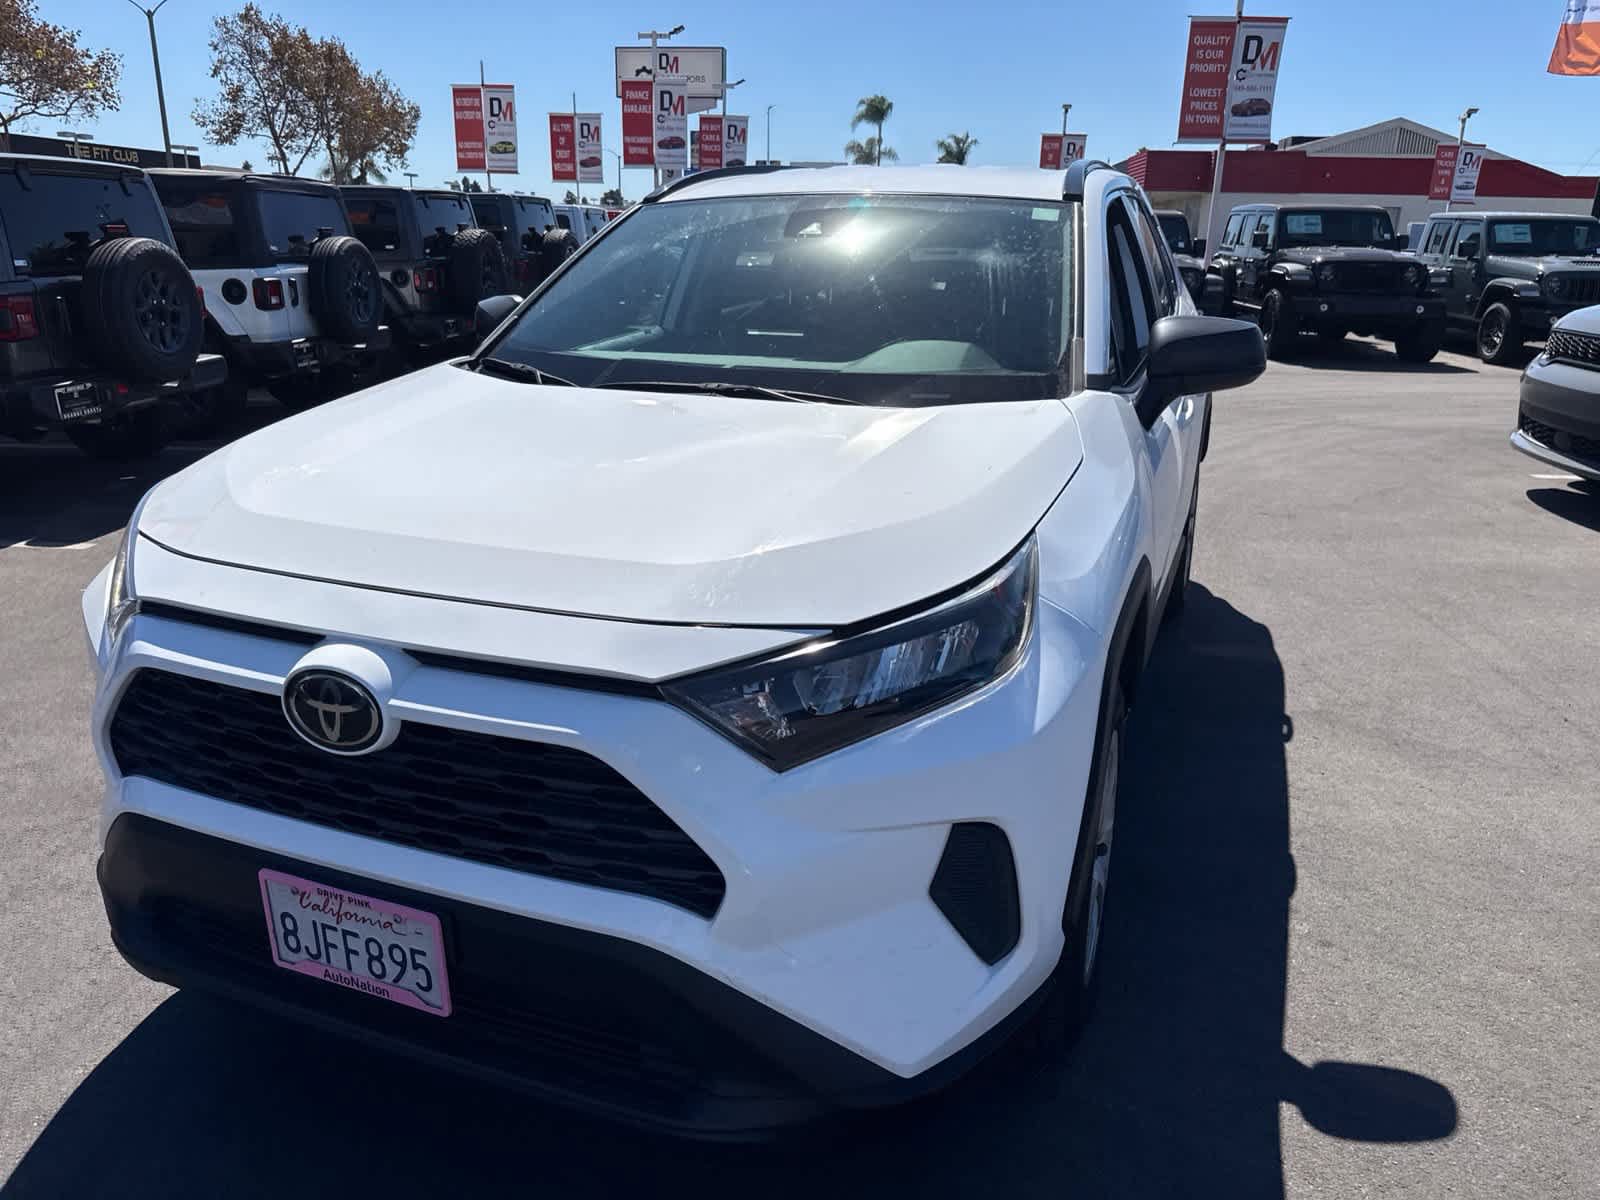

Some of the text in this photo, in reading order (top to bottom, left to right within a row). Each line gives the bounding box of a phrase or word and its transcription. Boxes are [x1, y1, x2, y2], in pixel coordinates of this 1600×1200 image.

[1193, 35, 1231, 46] QUALITY
[1196, 50, 1224, 59] IS OUR
[1189, 63, 1227, 73] PRIORITY
[1189, 87, 1221, 97] LOWEST
[1190, 101, 1218, 111] PRICES
[1184, 114, 1220, 124] IN TOWN
[93, 147, 111, 160] FIT
[112, 150, 140, 163] CLUB
[316, 887, 373, 909] DRIVE PINK
[299, 890, 408, 936] California
[280, 911, 433, 993] 8JFF895
[323, 968, 390, 998] AutoNation
